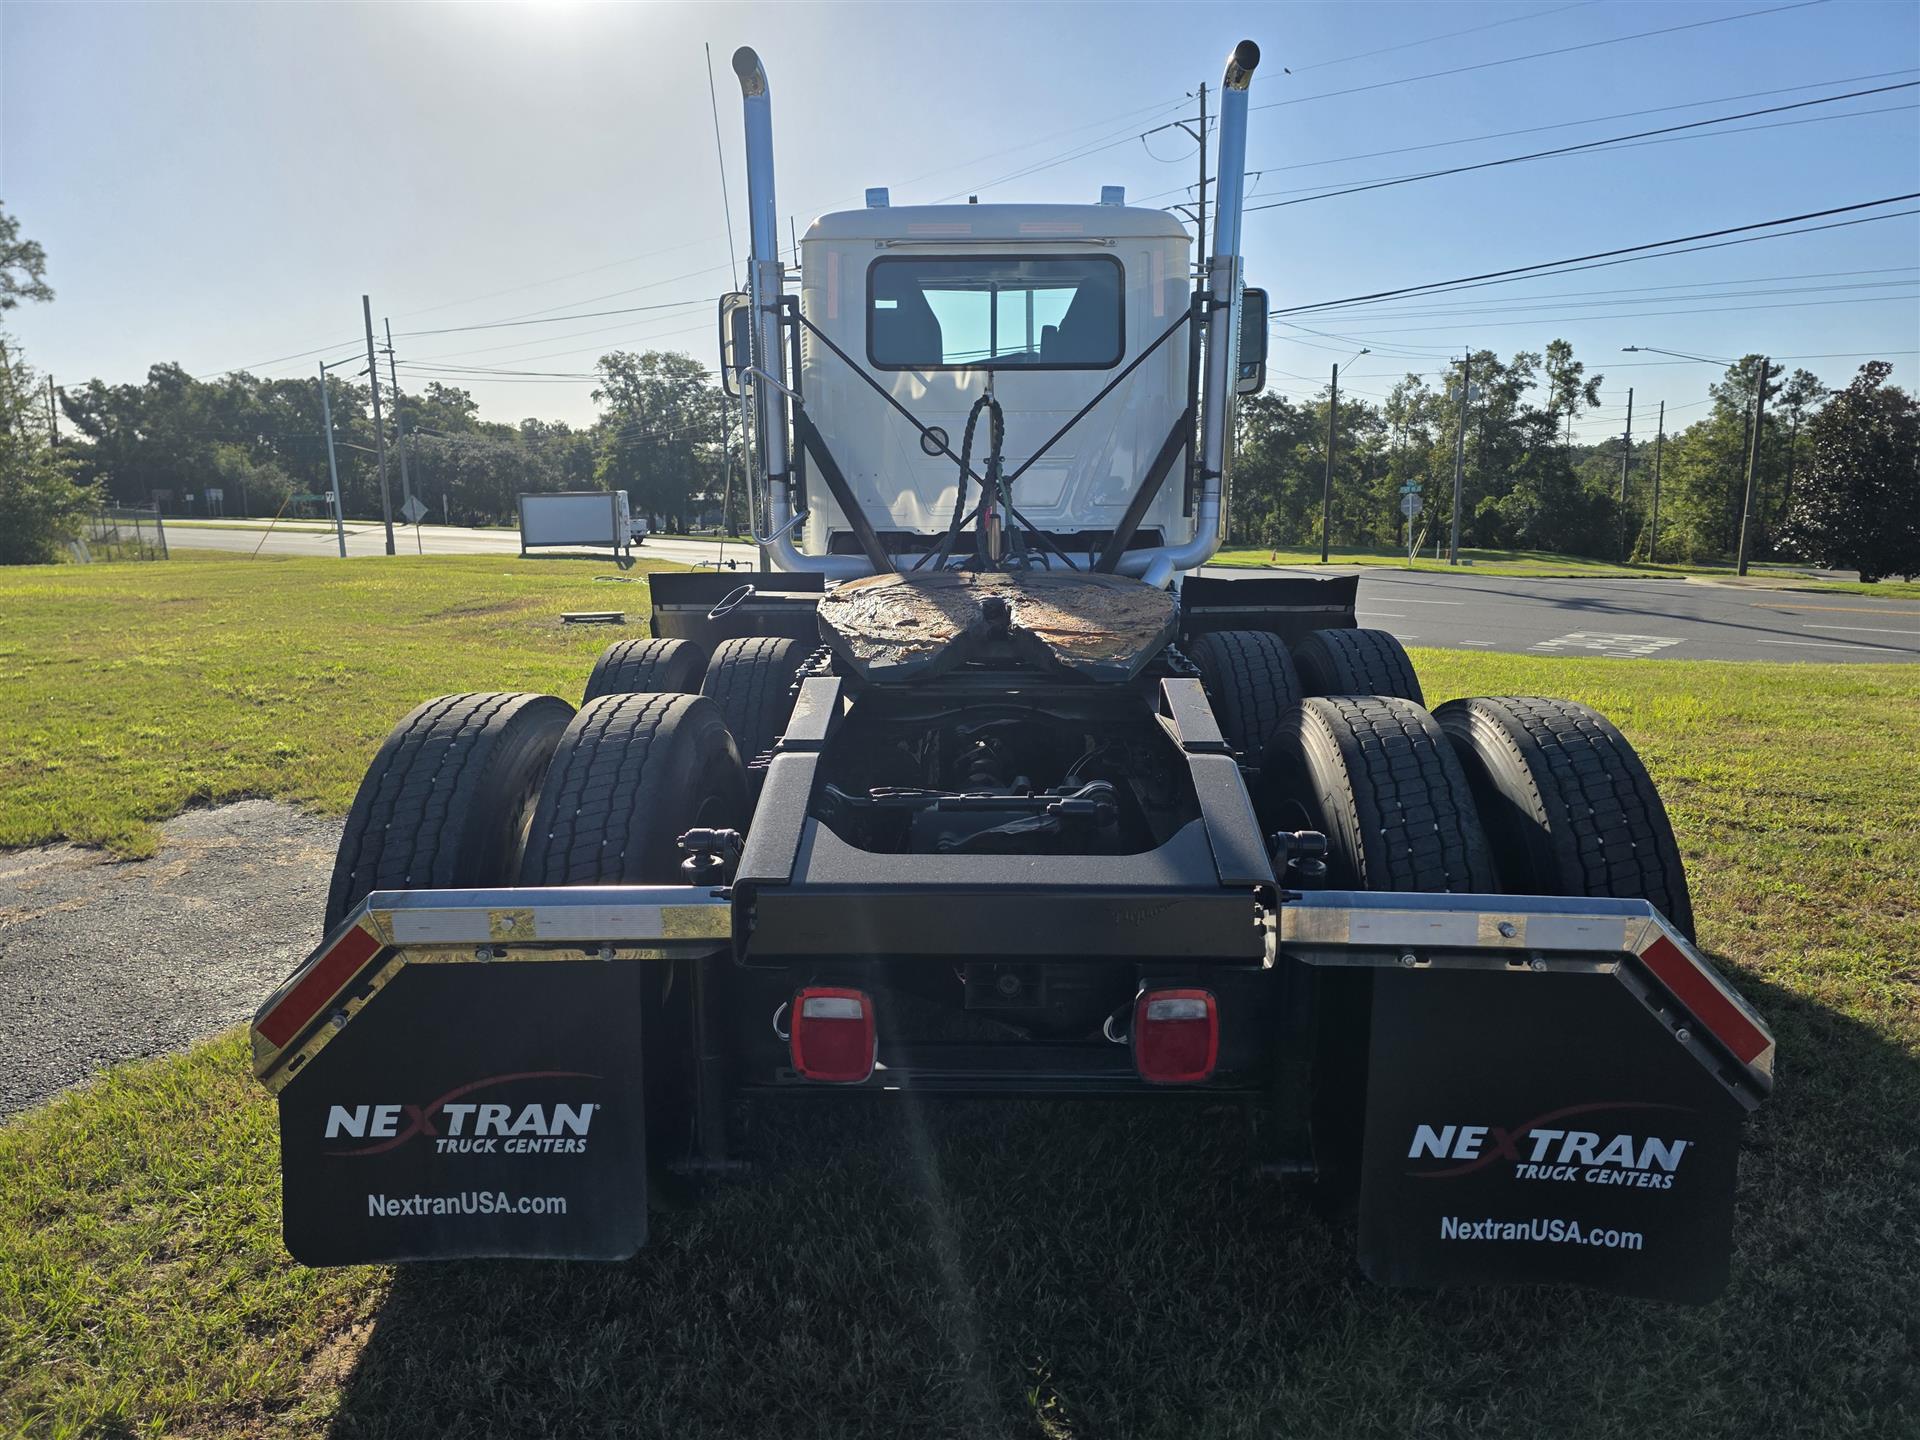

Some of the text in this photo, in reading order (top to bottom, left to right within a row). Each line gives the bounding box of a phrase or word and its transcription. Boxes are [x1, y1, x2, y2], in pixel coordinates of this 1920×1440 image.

[325, 1104, 596, 1138] NEXTRAN
[436, 1138, 587, 1154] TRUCK CENTERS
[1408, 1125, 1688, 1171] NEXTRAN
[1516, 1163, 1674, 1190] TRUCK CENTERS
[368, 1192, 567, 1217] NextranUSA.com
[1441, 1216, 1643, 1249] NextranUSA.com
